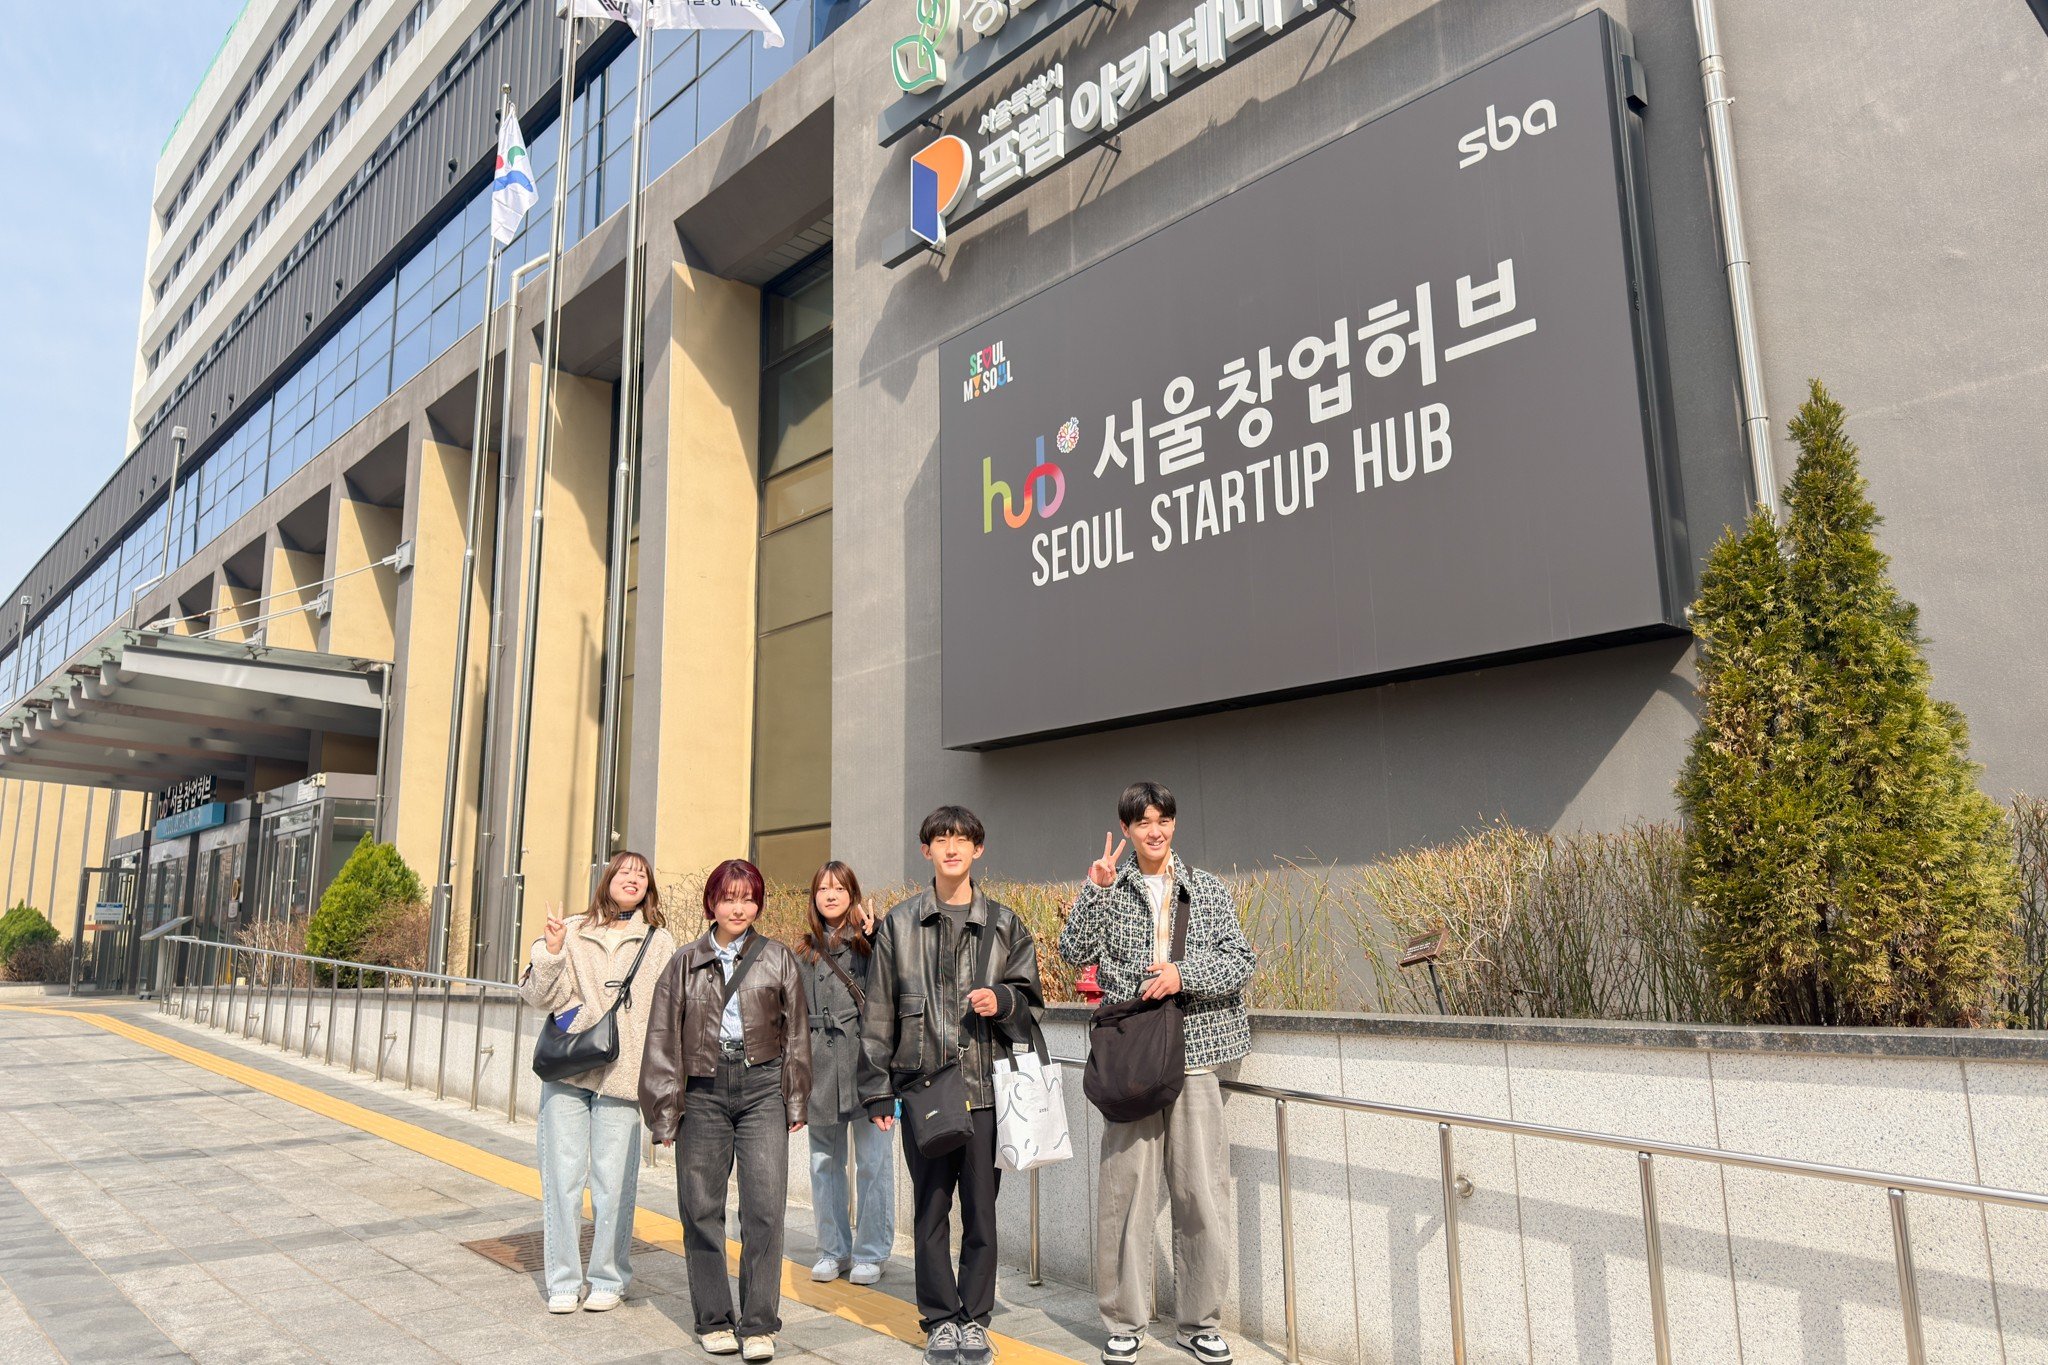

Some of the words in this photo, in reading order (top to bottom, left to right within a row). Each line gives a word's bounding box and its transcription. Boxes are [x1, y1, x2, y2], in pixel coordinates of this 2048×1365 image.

[978, 62, 1064, 135] 서울특별시
[1457, 98, 1558, 170] sba
[982, 360, 1014, 393] SOUL
[1093, 258, 1537, 485] 서울창업허브
[982, 435, 1066, 534] hub
[1031, 508, 1134, 587] SEOUL
[1151, 443, 1329, 552] STARTUP
[1353, 402, 1453, 494] HUB
